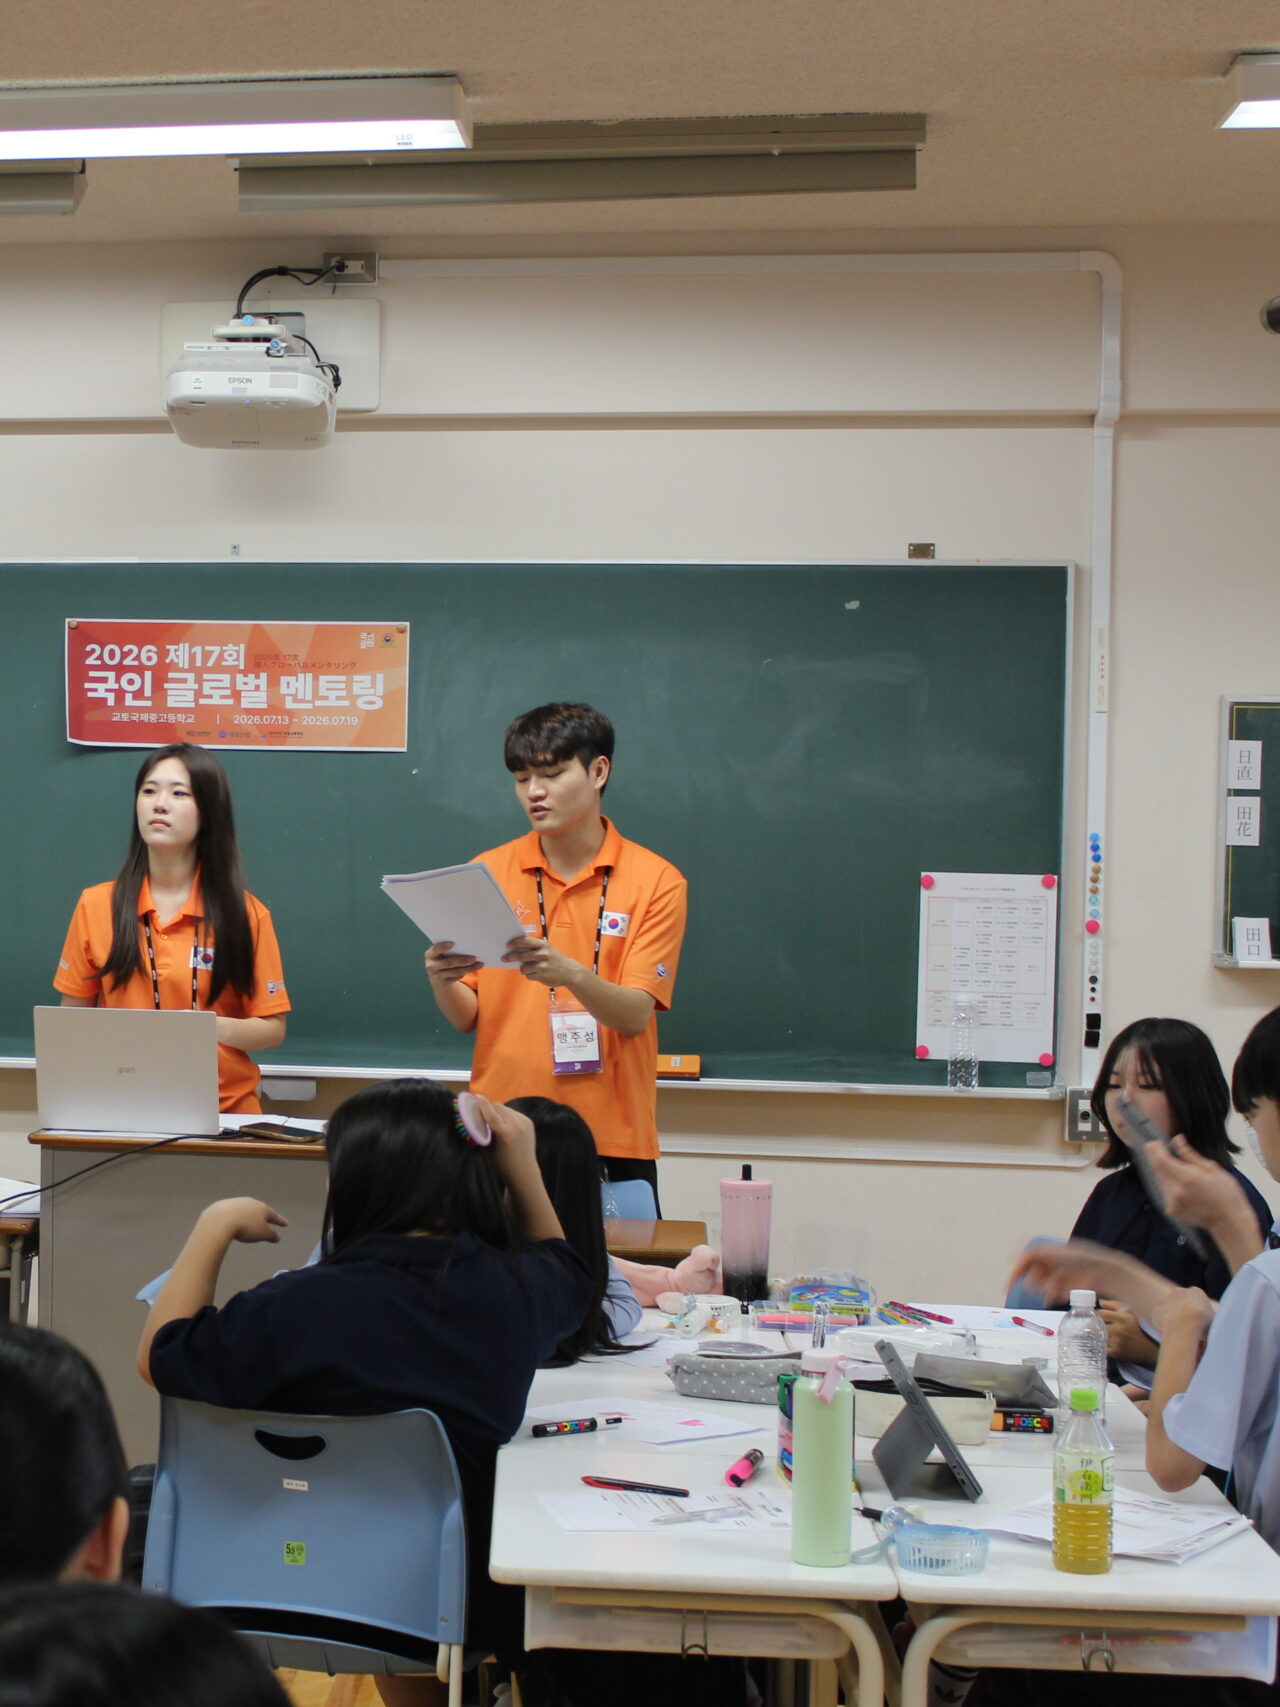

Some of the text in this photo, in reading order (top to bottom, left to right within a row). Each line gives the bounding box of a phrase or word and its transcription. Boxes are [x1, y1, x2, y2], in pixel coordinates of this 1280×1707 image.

[84, 642, 245, 670] 2026 제17회
[83, 670, 385, 711] 국인 글로벌 멘토링
[111, 712, 196, 724] 교토국제중고등학교
[233, 715, 289, 726] 2026.07.13
[301, 716, 359, 727] 2026.07.19
[1236, 750, 1253, 781] 日直
[1235, 806, 1252, 838] 田花
[1246, 927, 1261, 956] 田口
